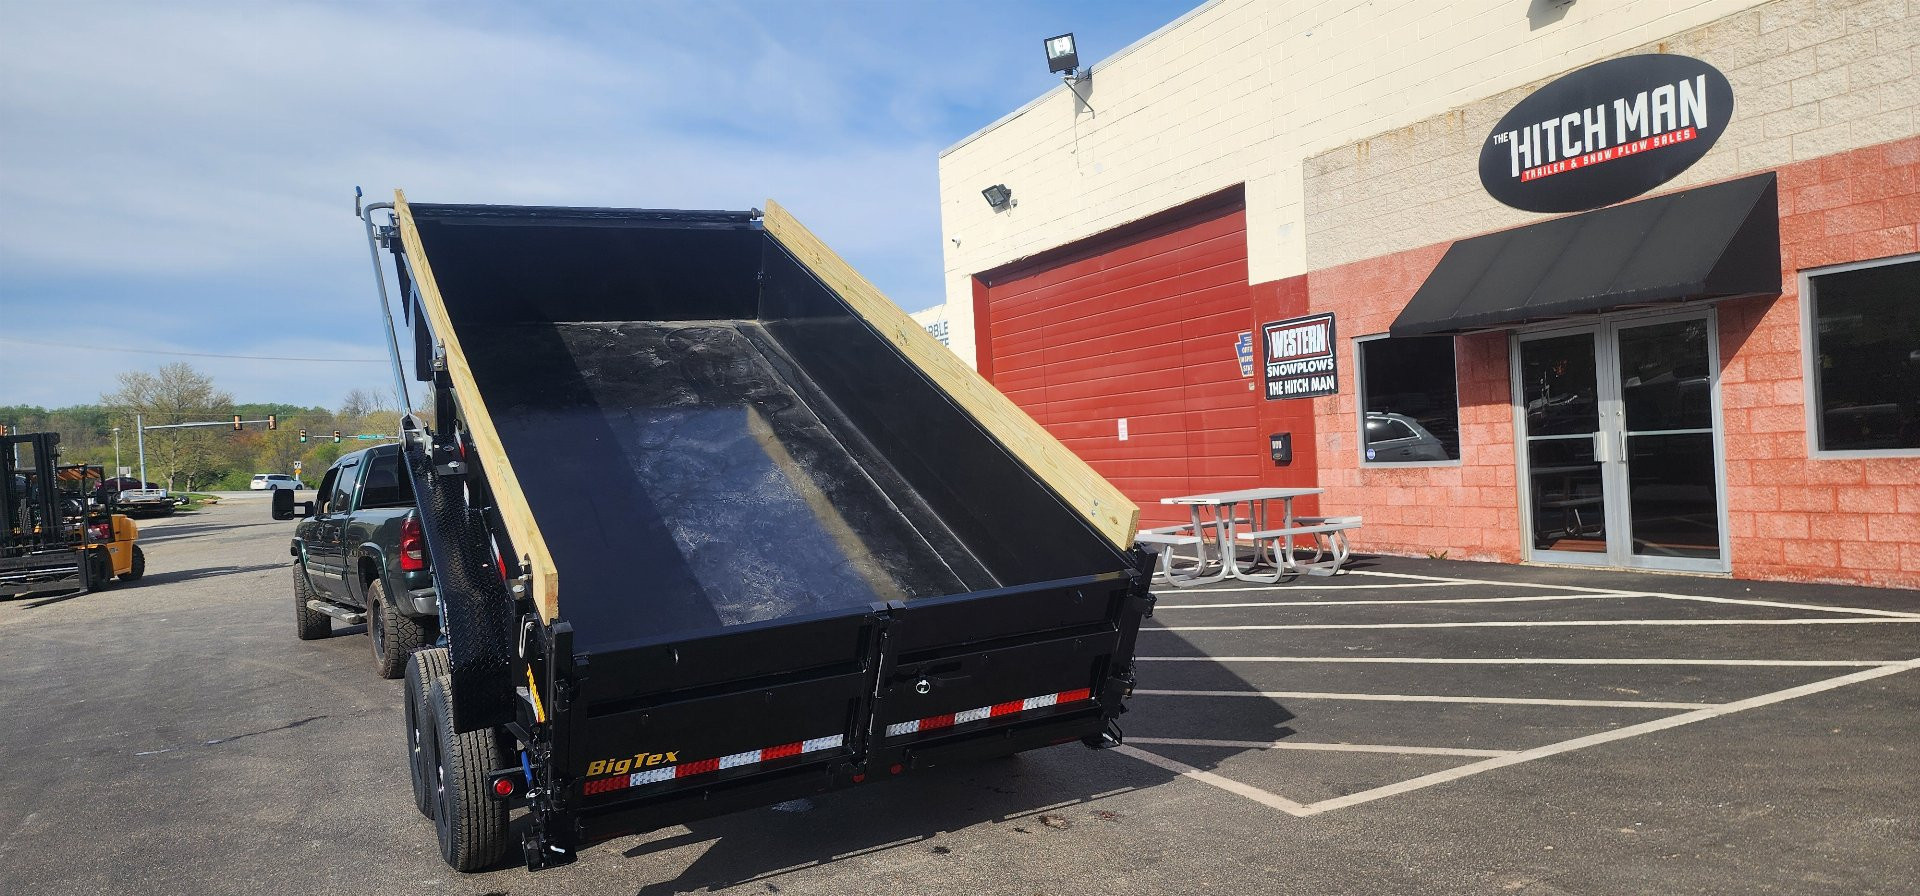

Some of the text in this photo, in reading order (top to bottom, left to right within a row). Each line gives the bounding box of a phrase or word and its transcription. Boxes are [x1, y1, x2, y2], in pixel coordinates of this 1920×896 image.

[1493, 74, 1708, 178] THE HITCH MAN
[1525, 130, 1691, 181] TRAILER & SNOW PLOW SALES
[923, 321, 949, 338] RBLE
[1271, 323, 1326, 359] WESTERN
[1267, 358, 1334, 378] SNOWPLOWS
[1269, 375, 1335, 396] THE HITCH MAN
